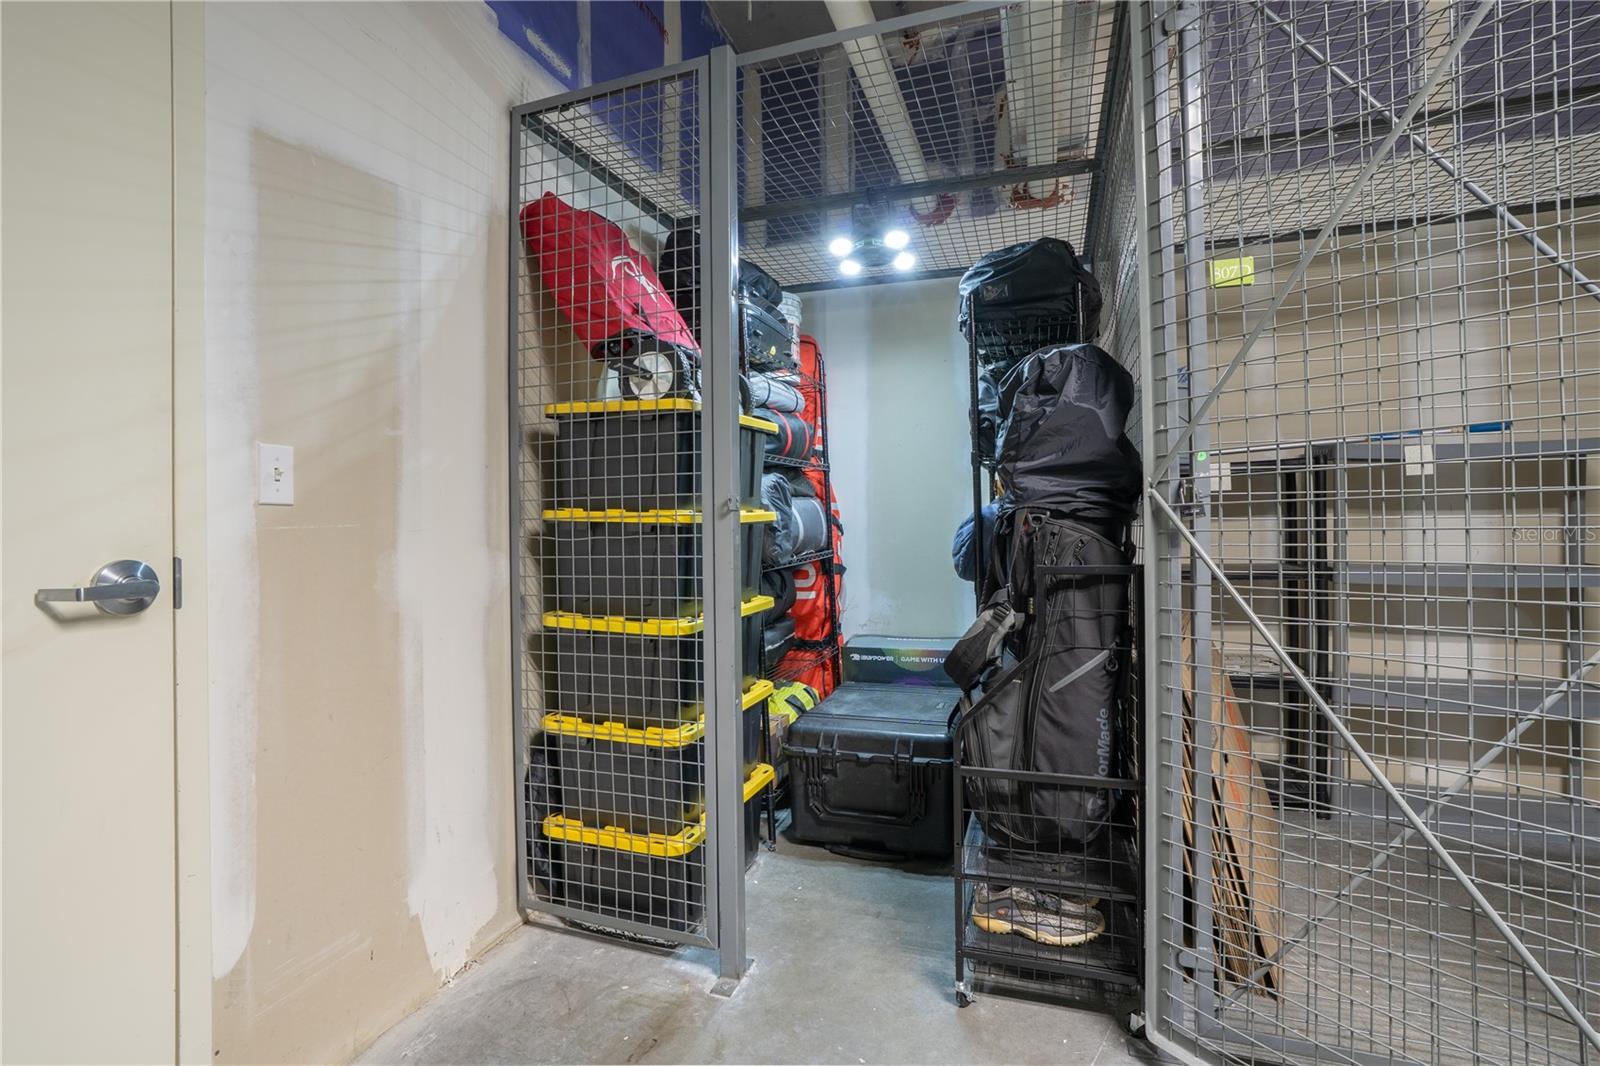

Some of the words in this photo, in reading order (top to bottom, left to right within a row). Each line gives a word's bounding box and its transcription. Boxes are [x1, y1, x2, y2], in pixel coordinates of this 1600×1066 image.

[900, 655, 920, 663] GAME
[920, 656, 938, 664] WITH
[1094, 707, 1111, 779] orMade
